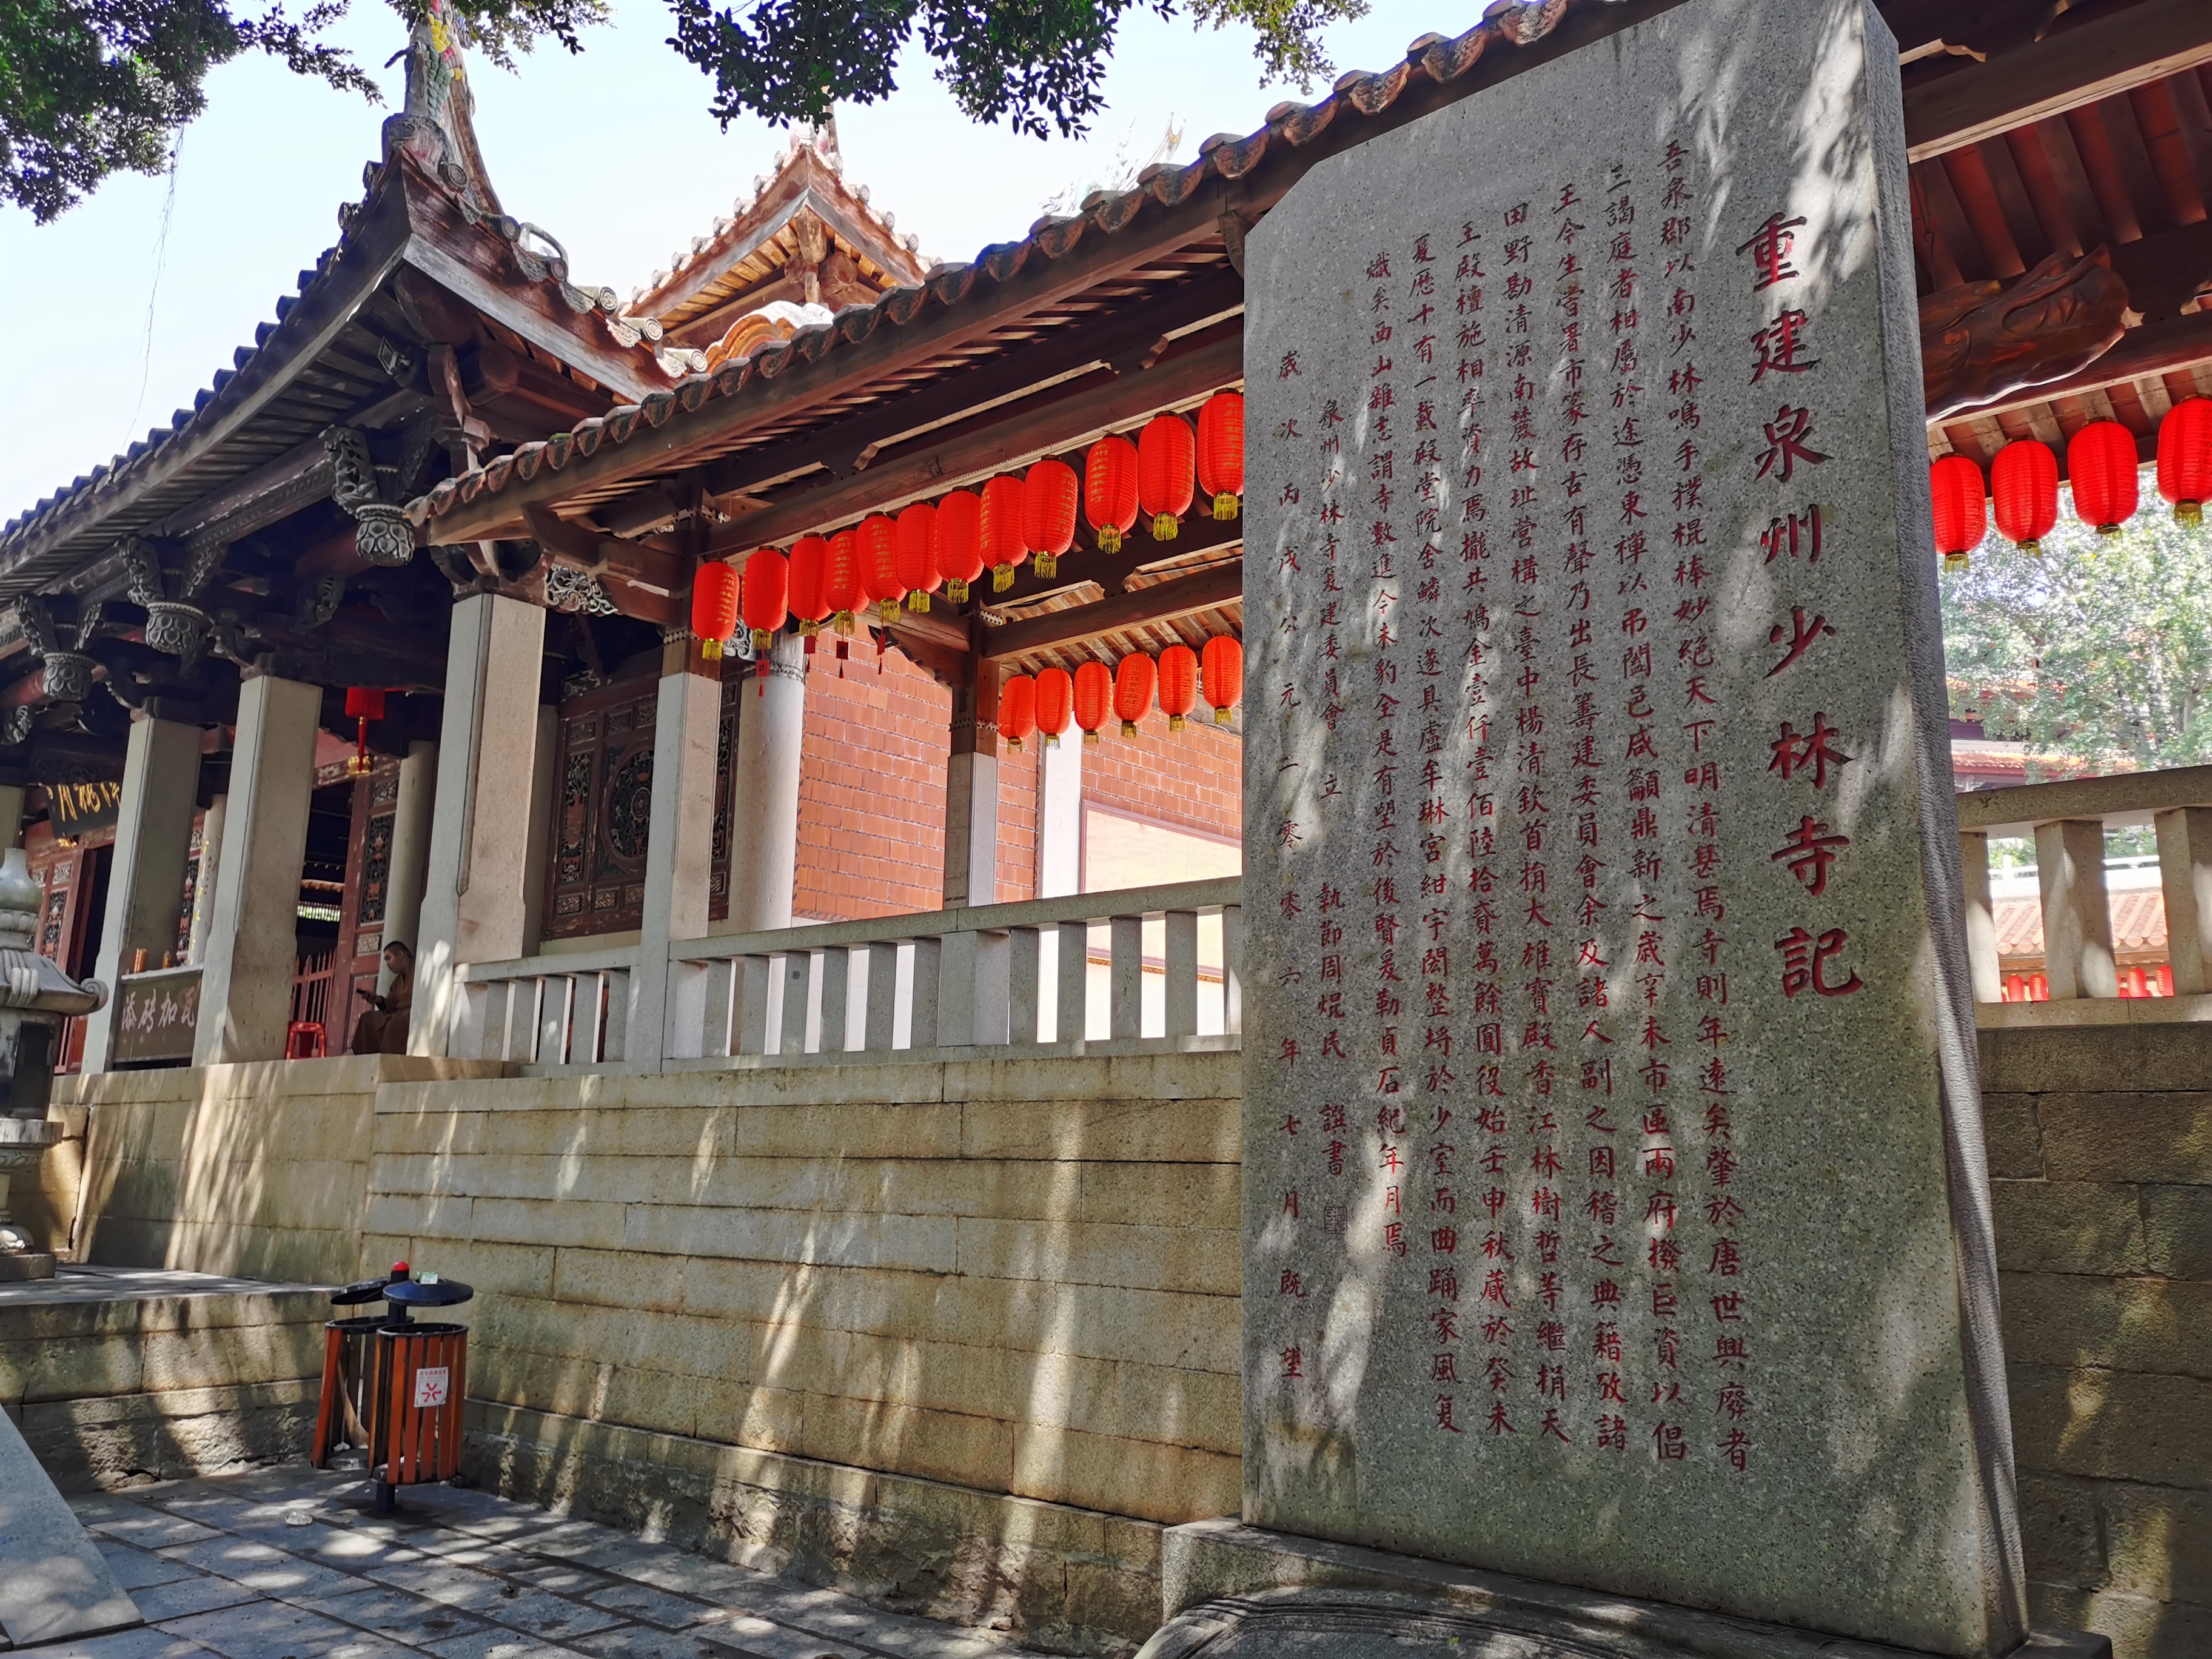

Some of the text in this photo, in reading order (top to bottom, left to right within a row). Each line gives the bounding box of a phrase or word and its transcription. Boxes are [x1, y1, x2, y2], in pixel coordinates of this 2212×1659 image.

[1736, 212, 1863, 999] 重建泉州少林寺記
